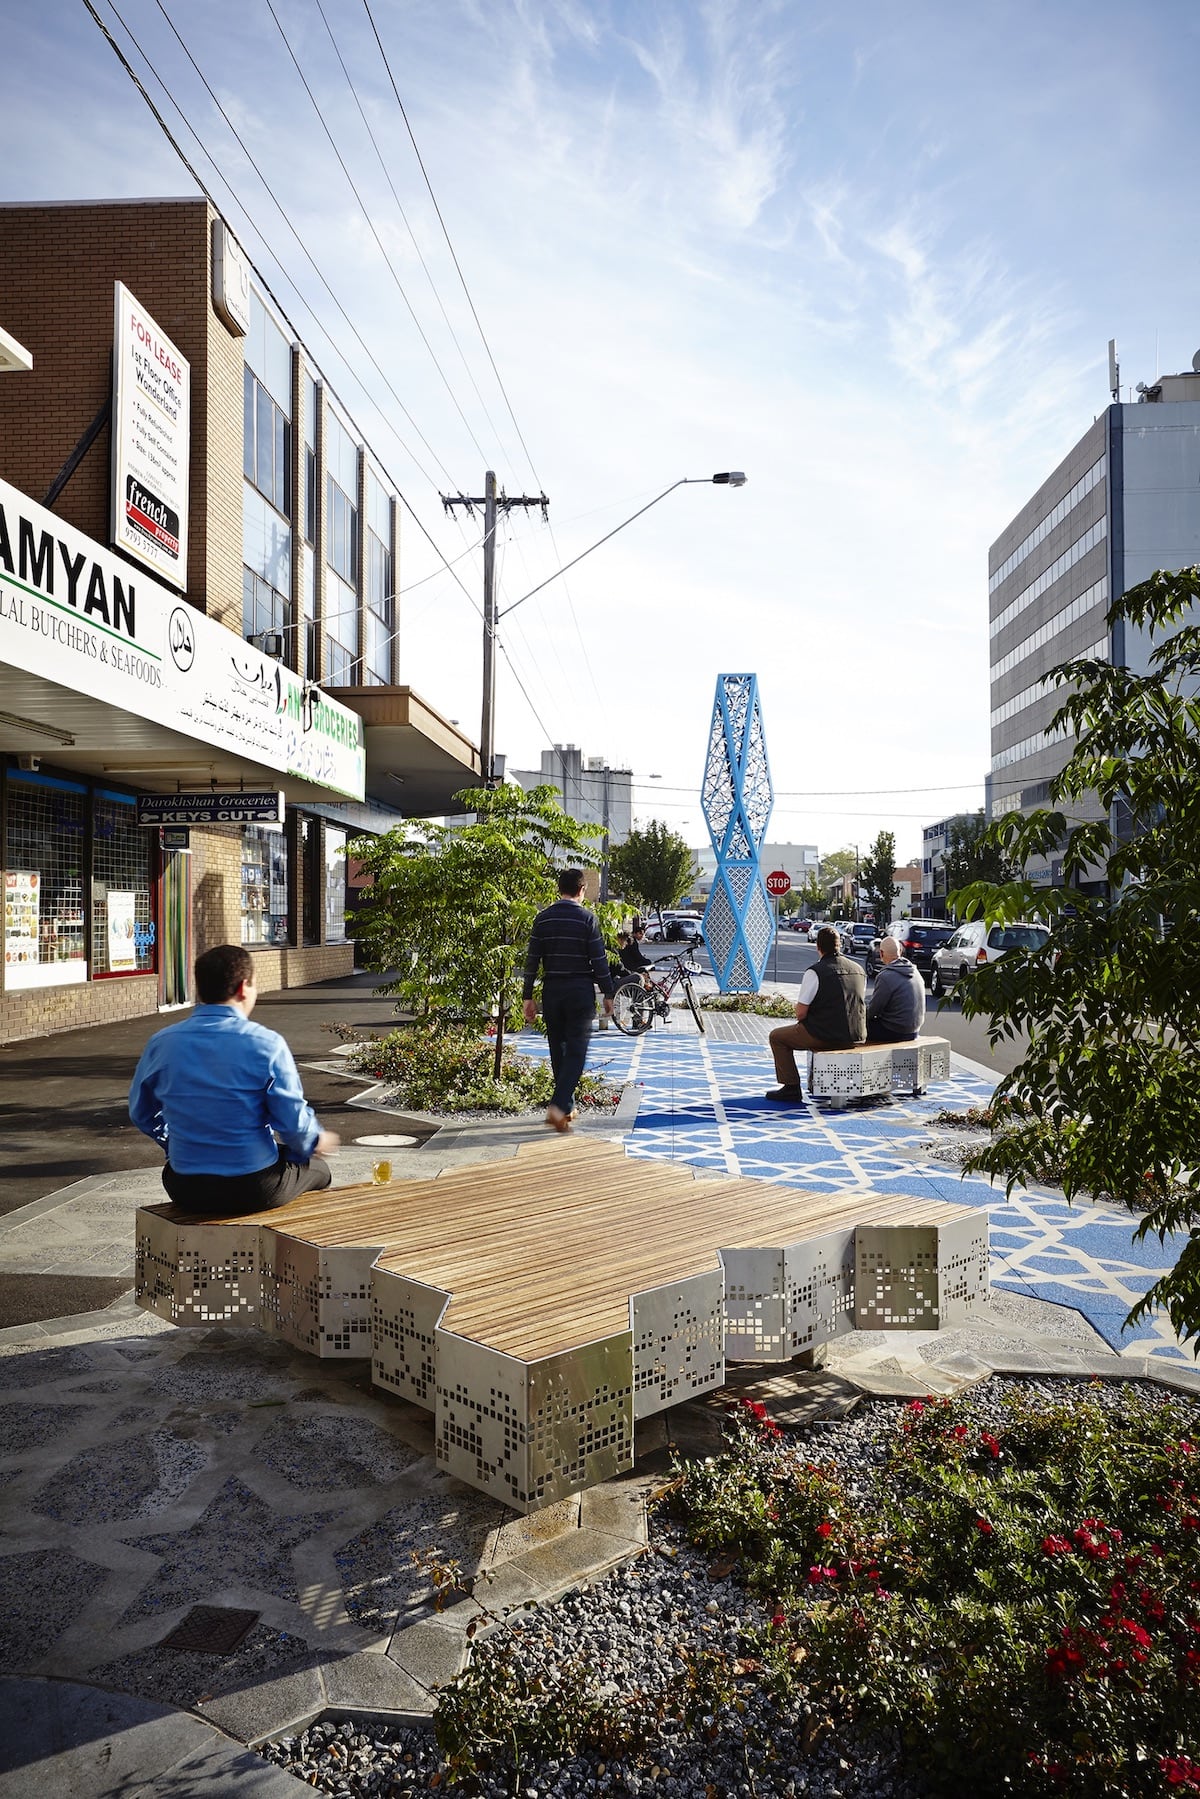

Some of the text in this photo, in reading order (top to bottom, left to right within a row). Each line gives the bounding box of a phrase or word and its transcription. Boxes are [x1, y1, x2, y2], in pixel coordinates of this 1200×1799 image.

[131, 314, 182, 385] FOR LEASE
[131, 344, 182, 408] 1st Floor Office
[136, 366, 177, 420] Wonderland
[136, 403, 173, 444] Fully Refurbished
[136, 421, 178, 466] Fully Self Contained
[136, 440, 147, 458] Size:
[126, 481, 168, 528] french
[125, 526, 158, 559] 9793 5777
[154, 526, 180, 552] property
[31, 606, 97, 659] BUTCHERS
[99, 640, 109, 664] &
[111, 645, 162, 689] SEAFOODS
[314, 701, 358, 752] GROCERIES
[140, 795, 277, 808] Darokhshan Groceries
[162, 810, 256, 822] KEYS CUT
[767, 878, 790, 888] STOP
